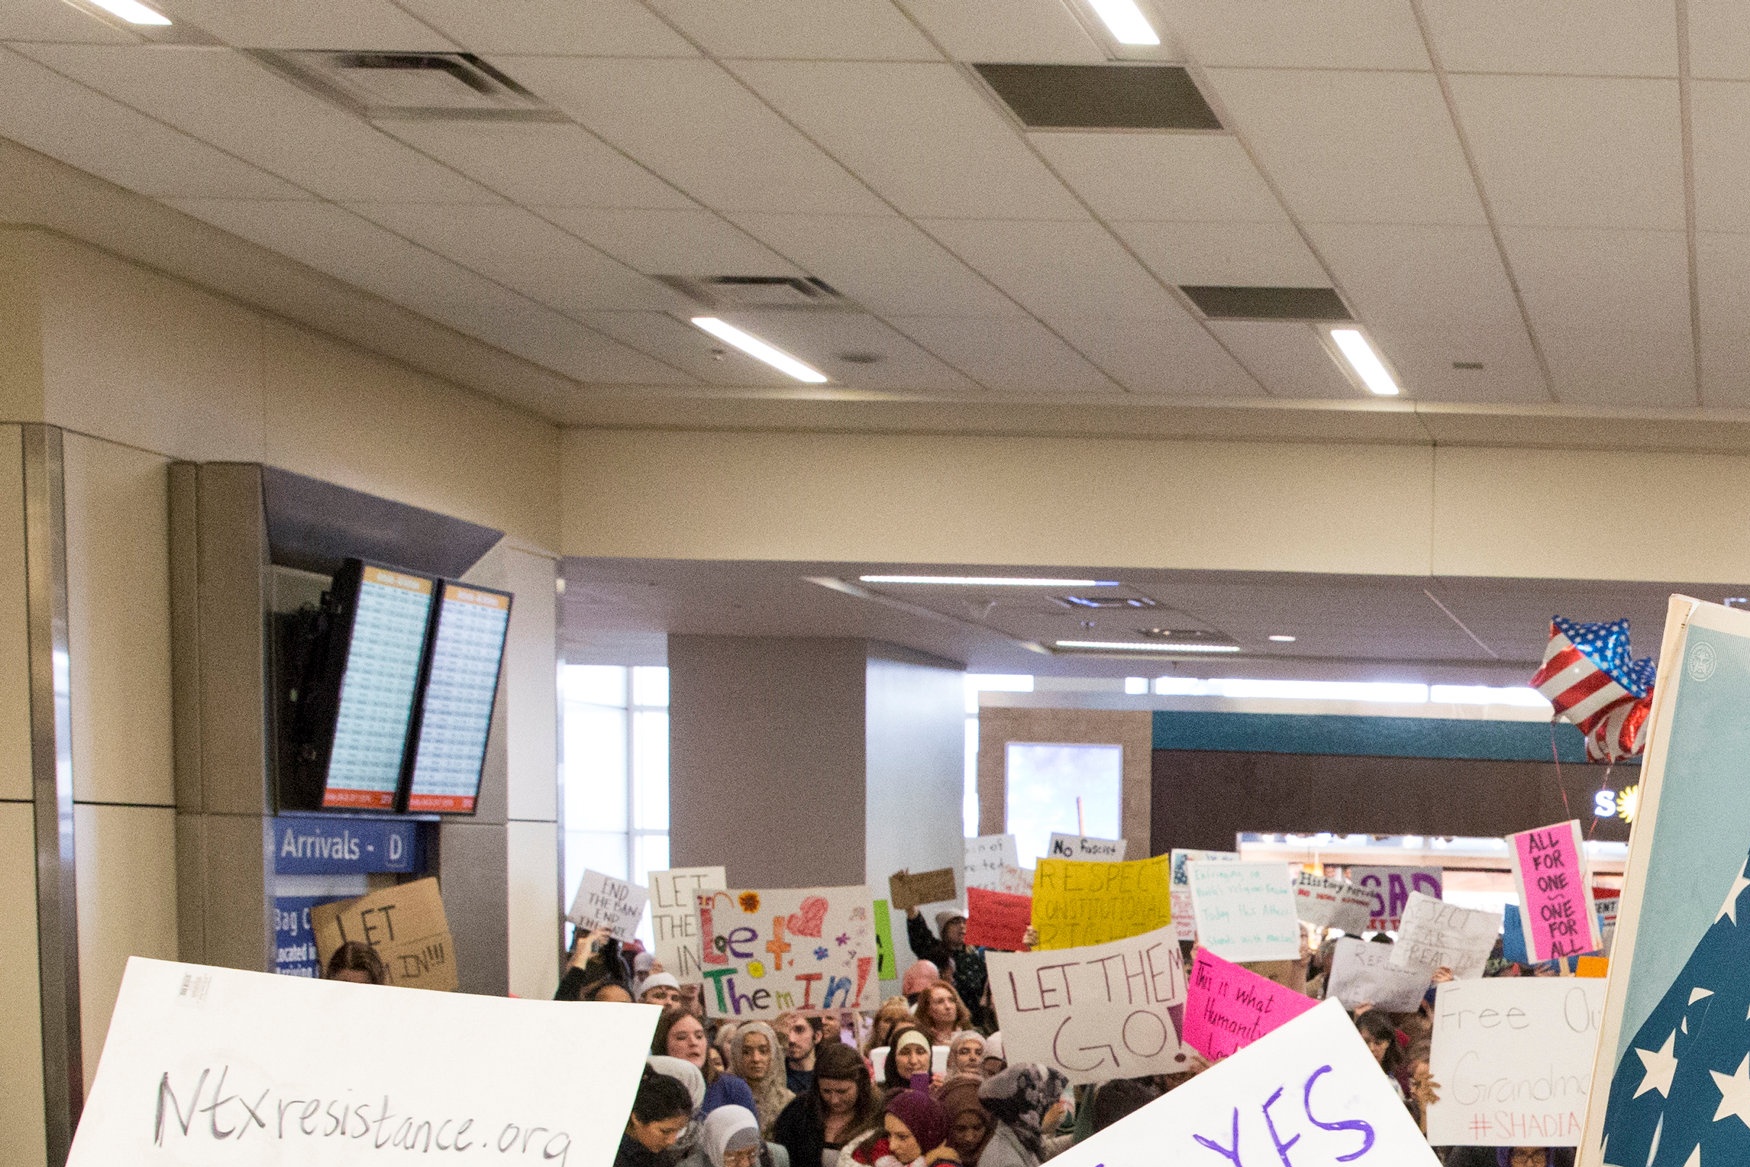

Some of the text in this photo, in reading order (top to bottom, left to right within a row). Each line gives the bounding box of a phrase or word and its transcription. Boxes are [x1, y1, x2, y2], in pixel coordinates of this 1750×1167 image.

[281, 828, 361, 861] Arrivals
[389, 834, 403, 861] D
[1053, 838, 1074, 858] No
[1529, 830, 1560, 854] ALL
[1039, 858, 1167, 894] RESPECT
[1533, 850, 1565, 872] FOR
[602, 877, 630, 901] END
[656, 874, 709, 908] LET
[1537, 873, 1570, 893] ONE
[589, 893, 639, 918] THE BAN
[1540, 899, 1576, 921] ONE
[335, 904, 396, 947] LET
[653, 914, 699, 941] THE
[699, 907, 792, 971] Let
[1549, 919, 1578, 939] FOR
[275, 943, 308, 963] ocated
[677, 945, 703, 977] IN
[1551, 939, 1584, 960] ALL
[702, 956, 874, 1015] Them In!
[1008, 942, 1189, 1013] LET THEM
[1235, 984, 1274, 1014] what
[1441, 986, 1600, 1034] Free Ou
[1053, 1002, 1187, 1073] GO!
[1468, 1111, 1582, 1141] #SHADIA
